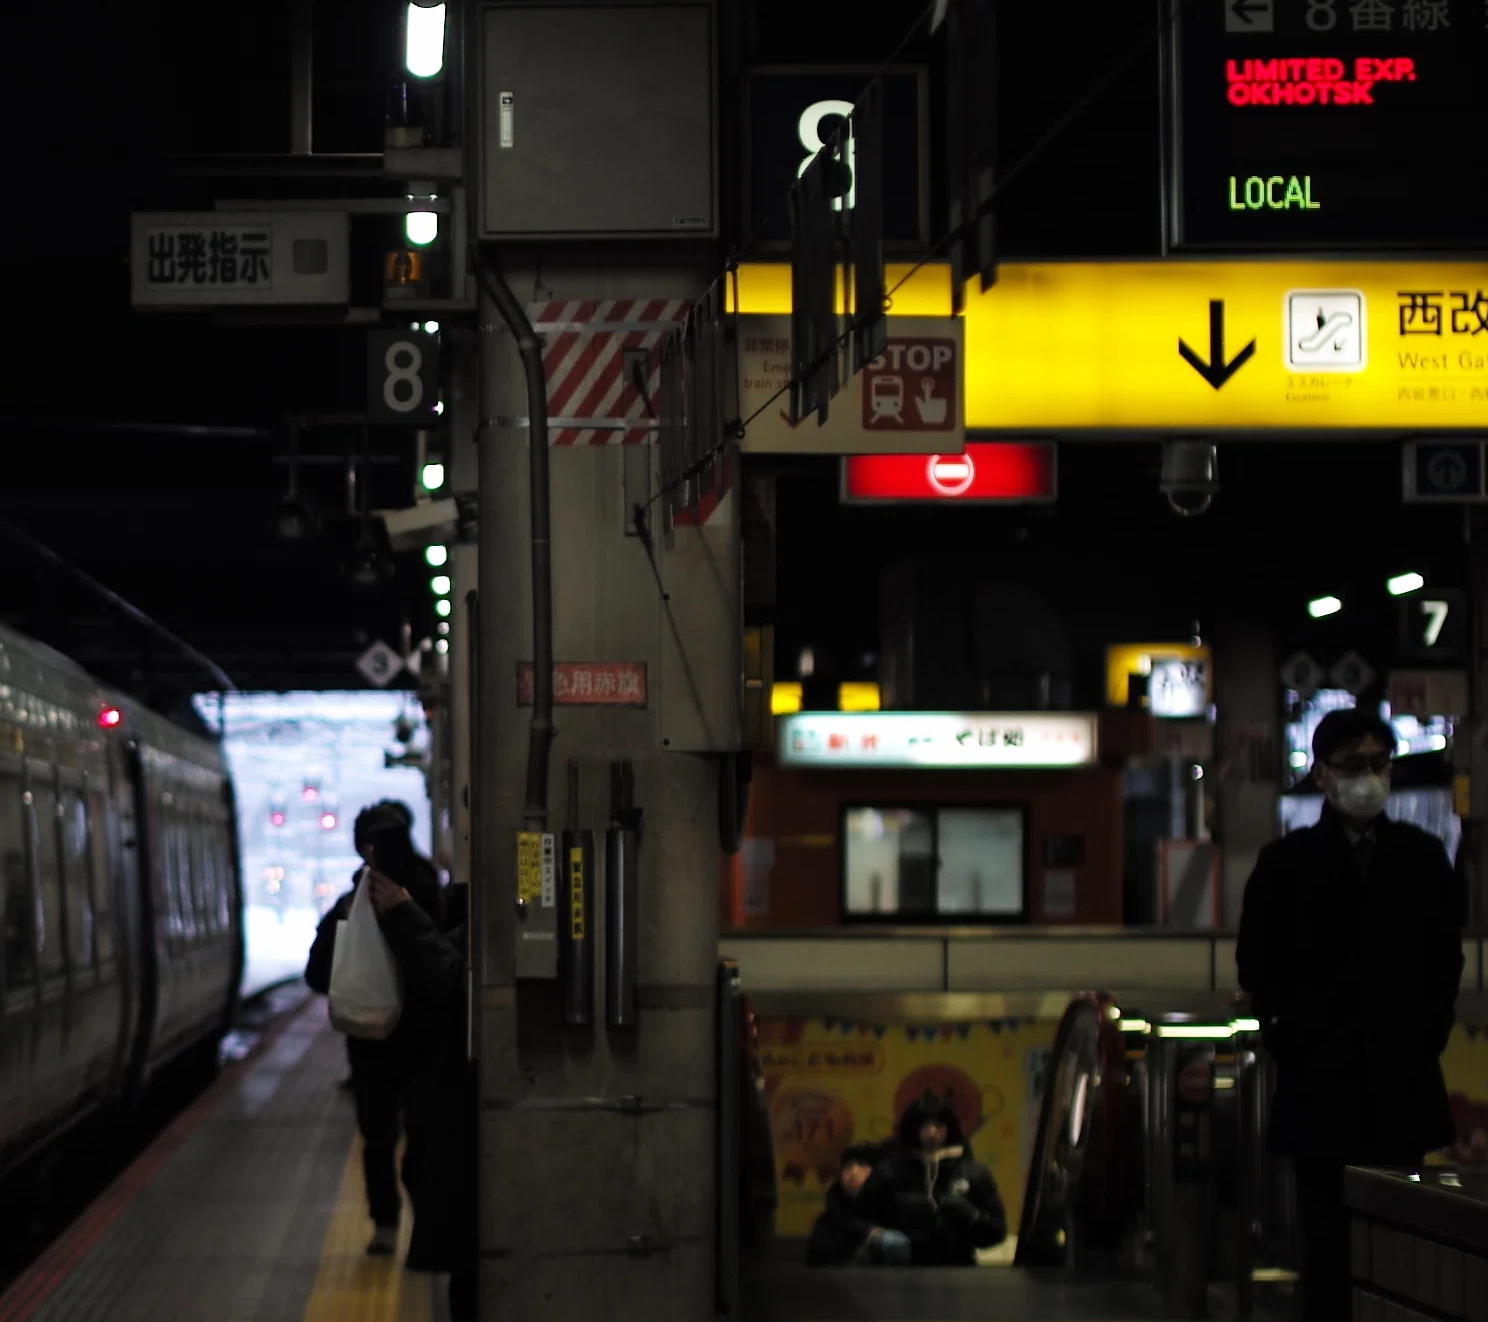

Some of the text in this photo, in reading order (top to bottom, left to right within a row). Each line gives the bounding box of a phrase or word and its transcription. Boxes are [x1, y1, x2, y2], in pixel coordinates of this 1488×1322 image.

[1224, 56, 1421, 83] LIMITED EXP.
[1225, 81, 1375, 107] OKHOTSK
[1229, 175, 1321, 209] LOCAL
[147, 231, 271, 283] 出発指示
[382, 340, 425, 413] 8
[1397, 350, 1448, 371] West
[1418, 599, 1450, 647] 7
